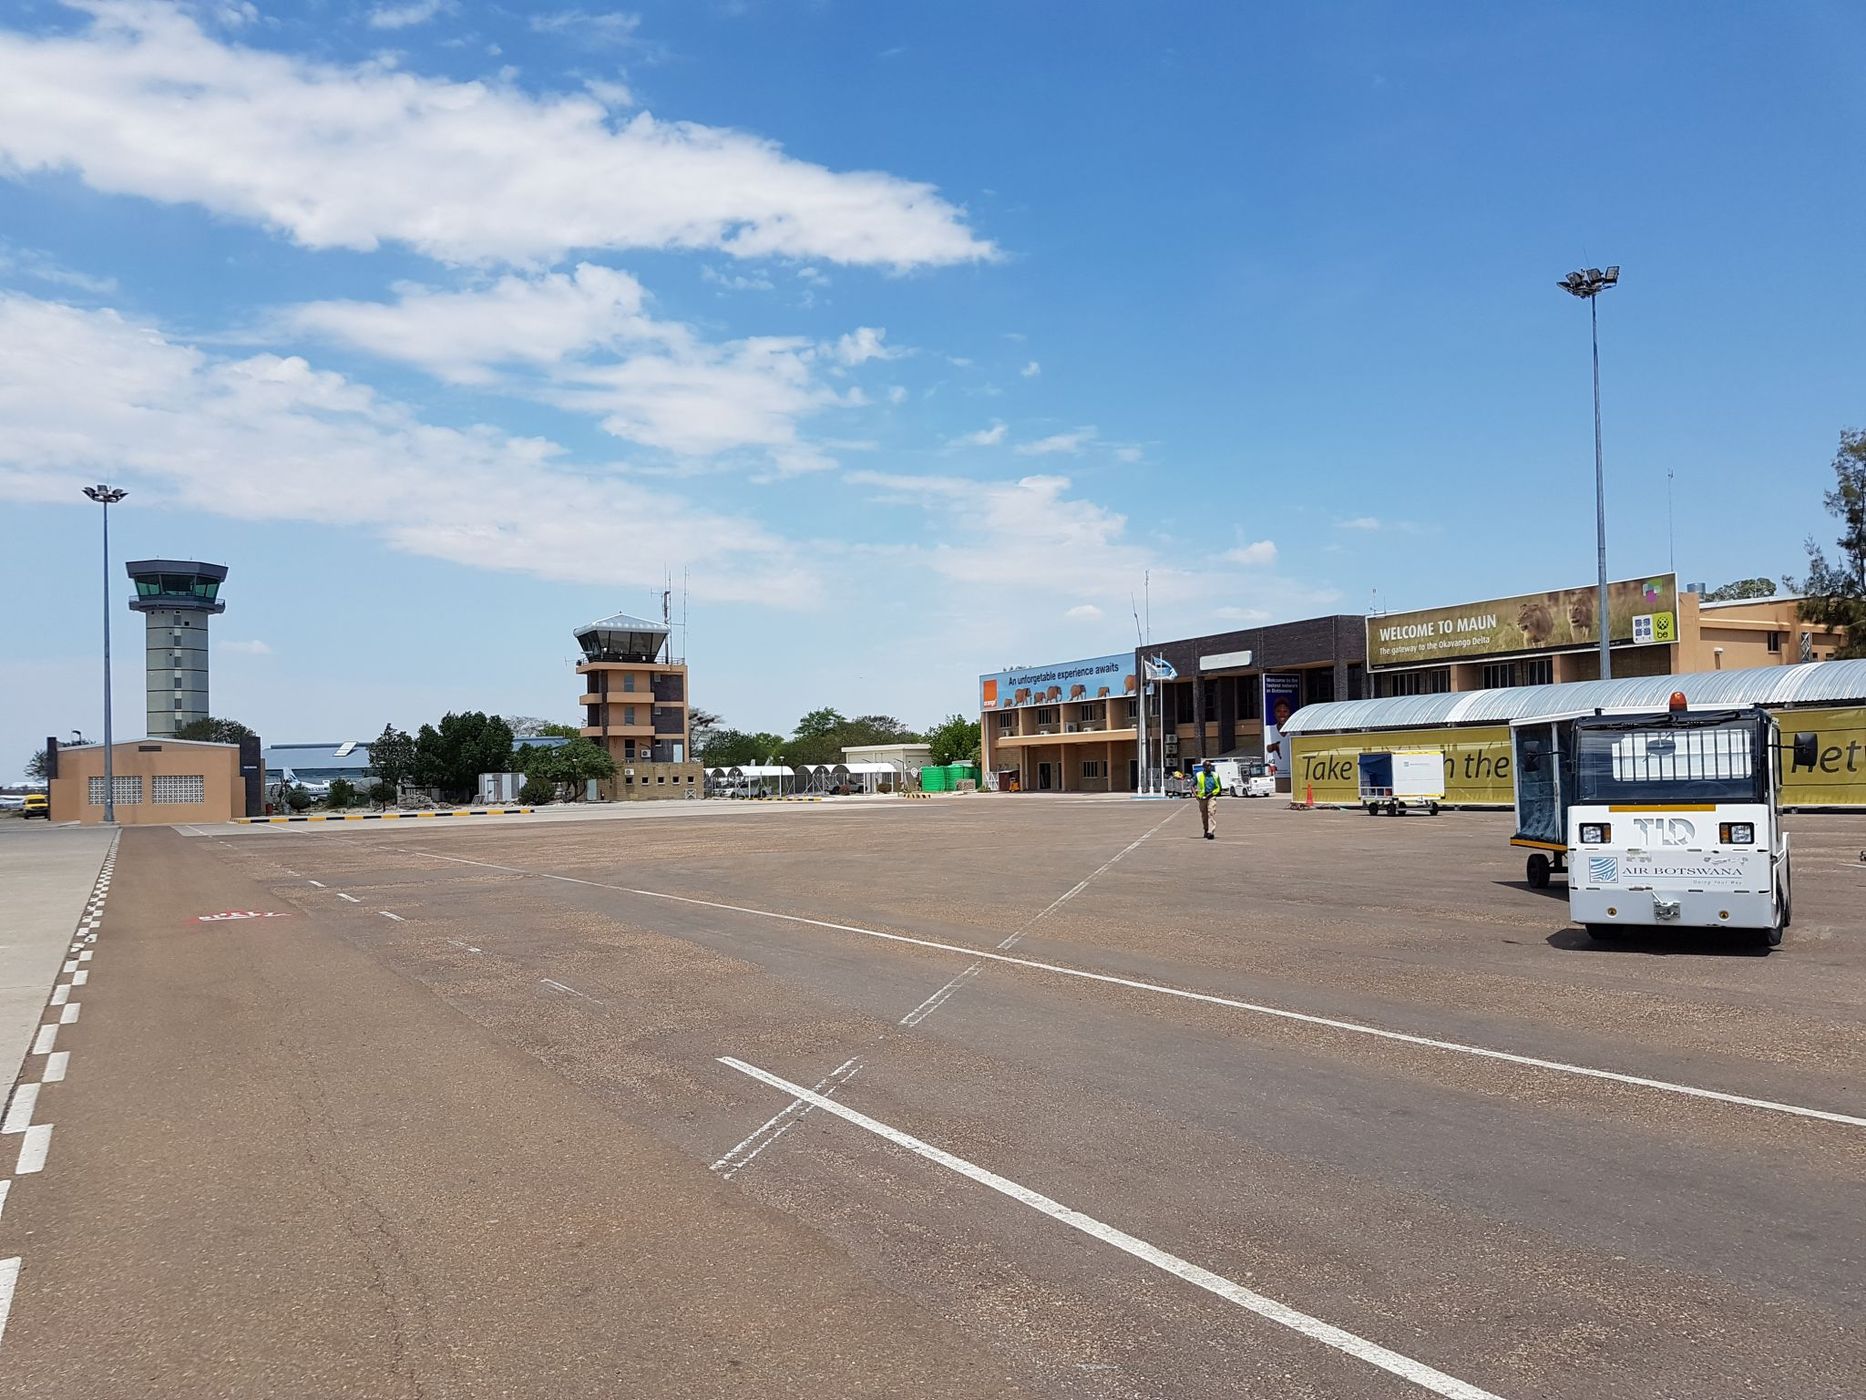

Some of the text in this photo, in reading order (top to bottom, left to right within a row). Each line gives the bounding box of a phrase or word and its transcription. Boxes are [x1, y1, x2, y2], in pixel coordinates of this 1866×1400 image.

[1380, 614, 1496, 641] WELCOME TO MAUN
[1656, 630, 1668, 639] be
[1379, 647, 1390, 655] The
[1391, 643, 1417, 655] gateway
[1418, 643, 1425, 651] to
[1426, 641, 1437, 650] the
[1472, 636, 1490, 645] Delta
[1008, 662, 1119, 686] An unforgetable experience awaits
[1302, 755, 1352, 780] Take
[1464, 749, 1509, 779] the
[1633, 818, 1696, 846] TLD
[1622, 867, 1743, 876] AIR BOTSWANA
